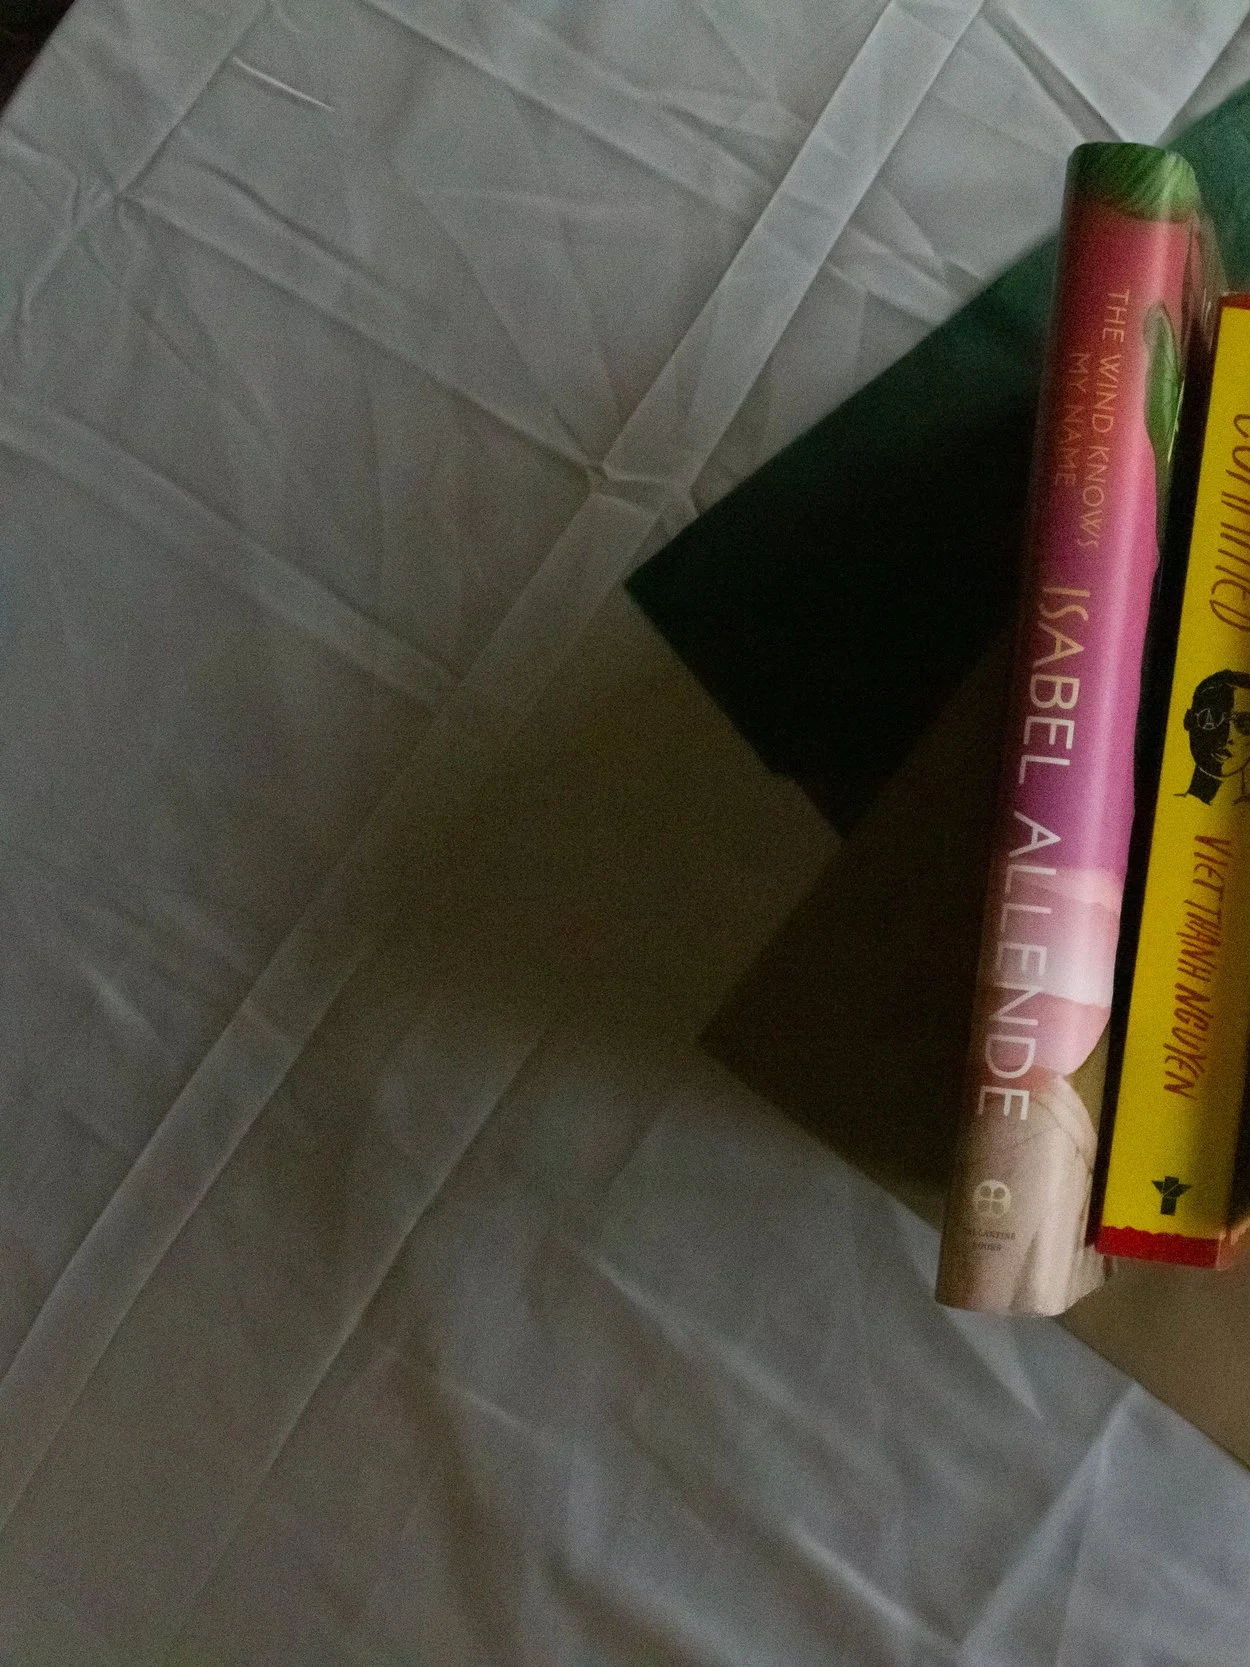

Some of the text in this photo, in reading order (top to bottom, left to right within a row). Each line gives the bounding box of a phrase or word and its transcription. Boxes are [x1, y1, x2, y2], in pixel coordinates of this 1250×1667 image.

[1052, 351, 1092, 489] MY NAME
[1076, 288, 1130, 549] THE WIND KNOWS
[977, 585, 1092, 1122] ISABEL ALLENDE
[1163, 834, 1236, 1097] VIET THANH NGUYEN
